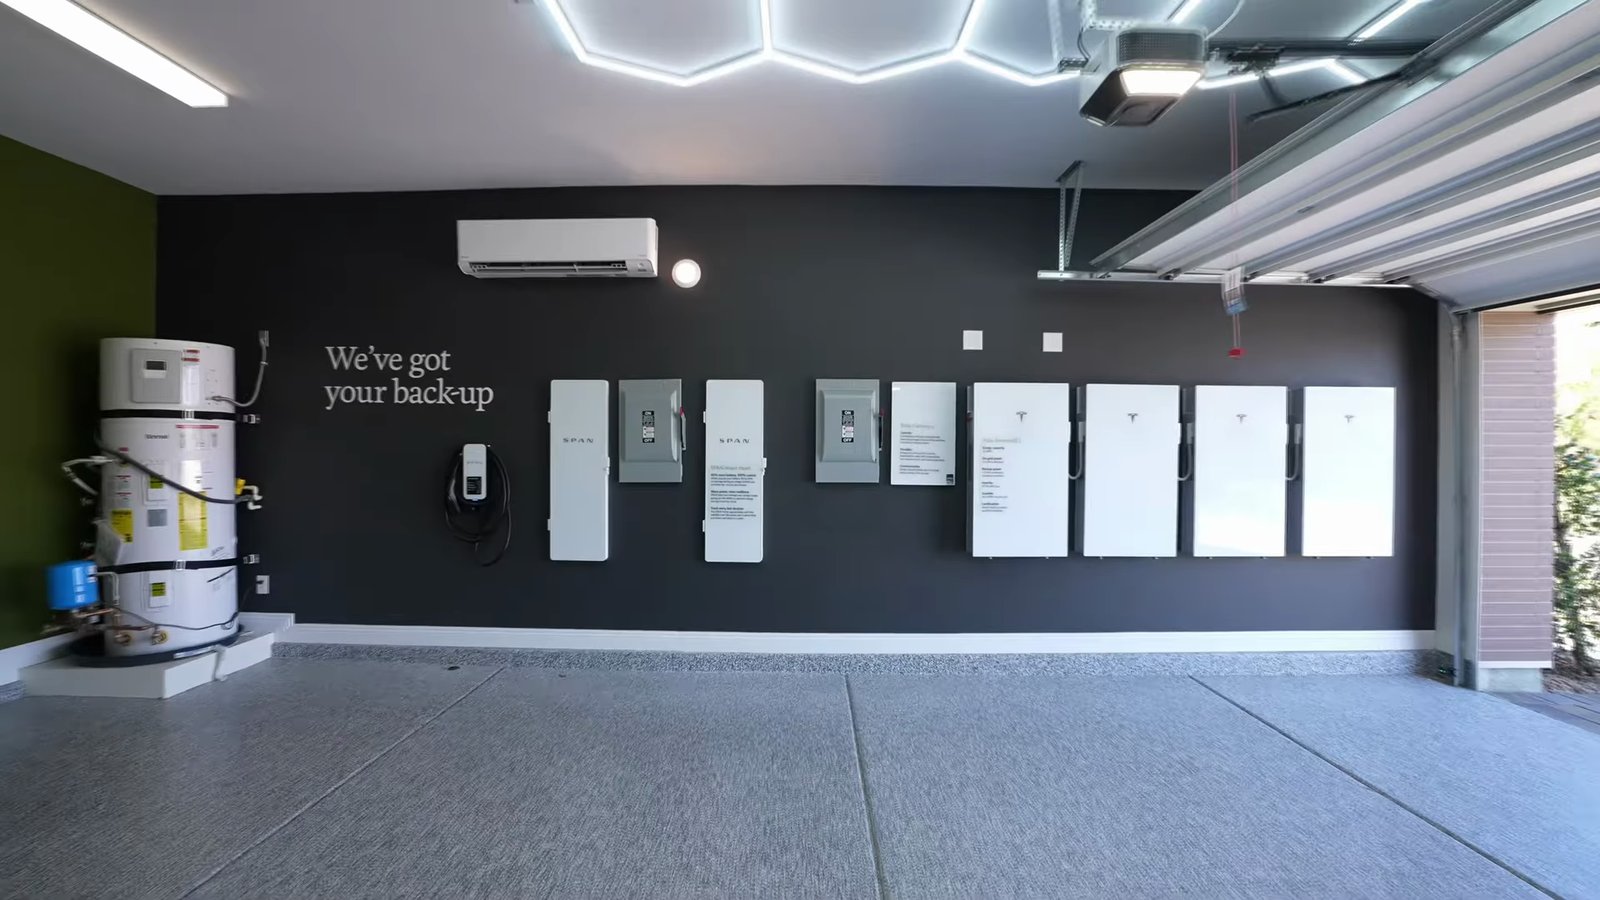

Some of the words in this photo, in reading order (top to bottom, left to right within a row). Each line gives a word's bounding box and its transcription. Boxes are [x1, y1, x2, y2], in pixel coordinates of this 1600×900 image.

[325, 345, 403, 371] We’ve
[409, 350, 451, 379] got
[325, 385, 388, 410] your
[391, 376, 494, 412] back-up
